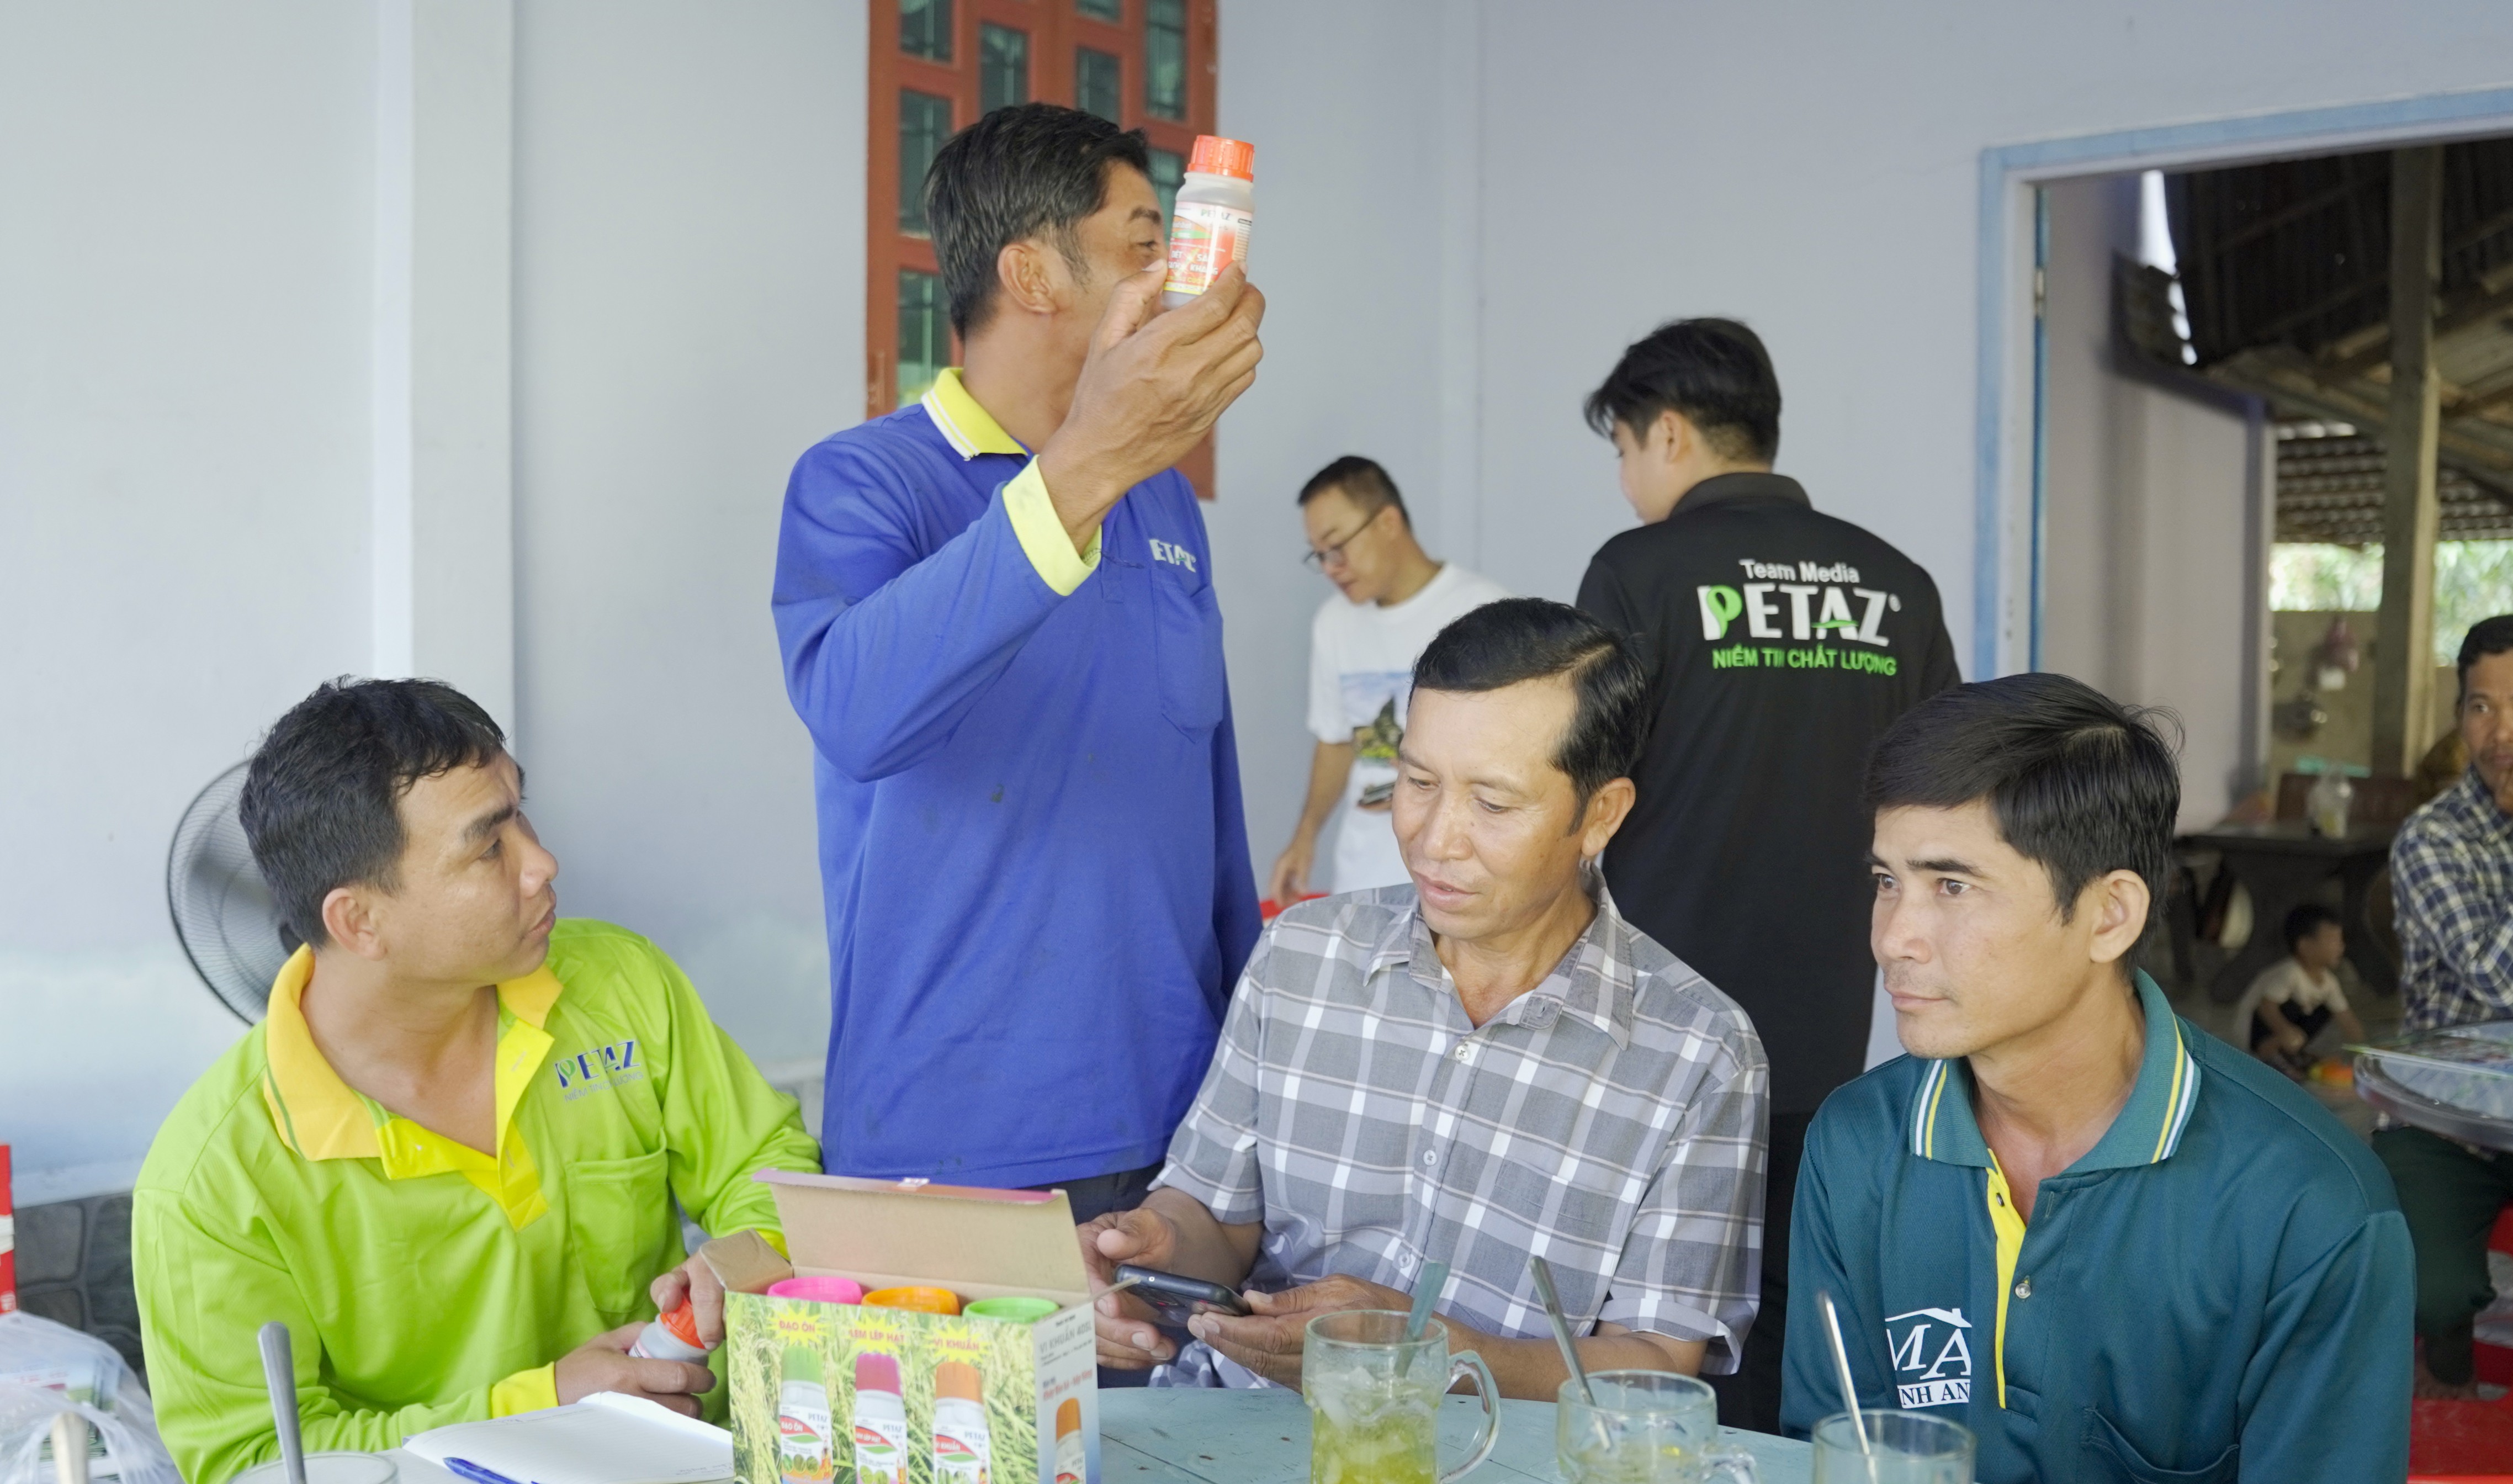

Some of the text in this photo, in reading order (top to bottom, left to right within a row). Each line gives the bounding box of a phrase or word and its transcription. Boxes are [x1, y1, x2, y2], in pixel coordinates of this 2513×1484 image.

[1201, 209, 1232, 221] PEAZ
[1149, 539, 1196, 573] ETAZ
[1738, 559, 1860, 583] Team Media
[1941, 1382, 1970, 1401] AN
